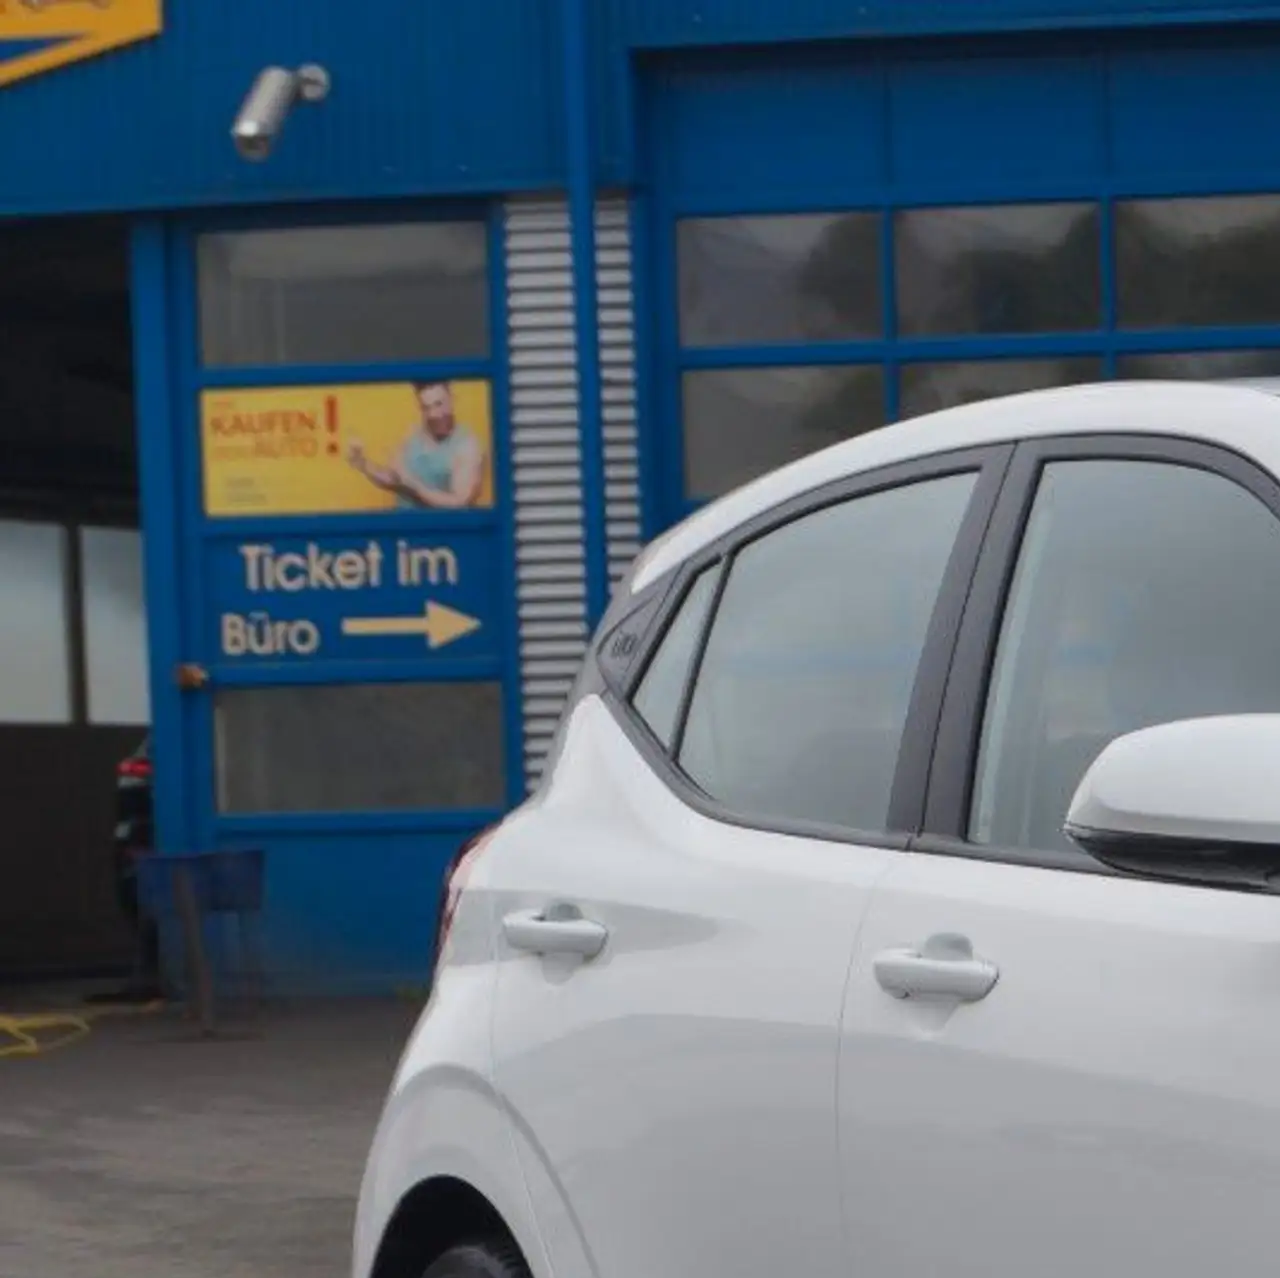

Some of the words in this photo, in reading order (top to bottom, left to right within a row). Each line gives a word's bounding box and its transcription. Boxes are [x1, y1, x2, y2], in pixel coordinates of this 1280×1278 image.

[239, 540, 383, 592] Ticket
[396, 540, 459, 586] im
[221, 611, 319, 656] Büro
